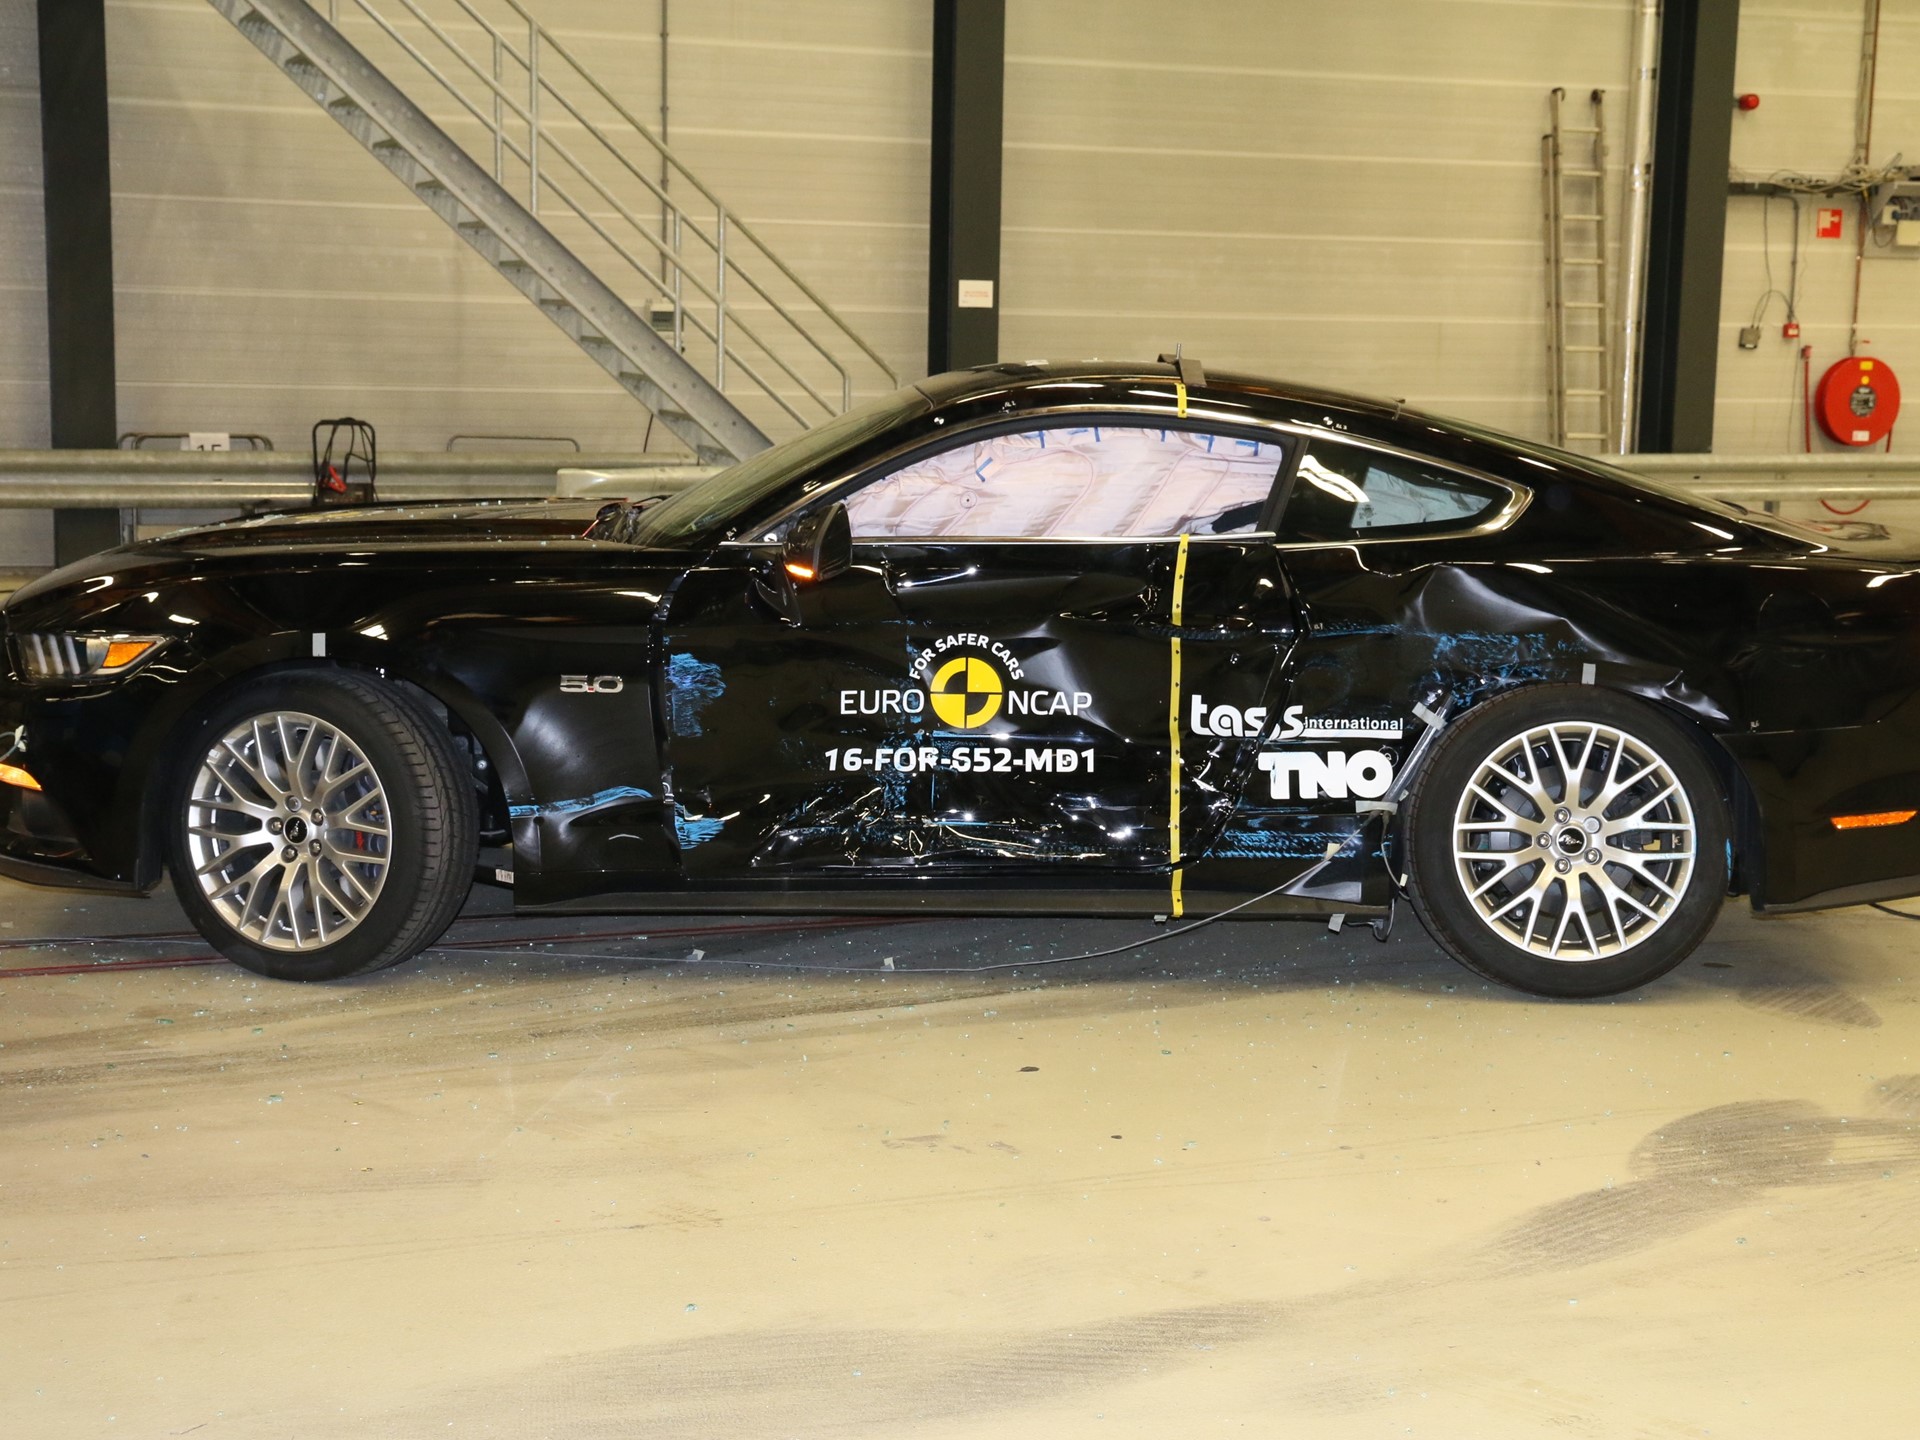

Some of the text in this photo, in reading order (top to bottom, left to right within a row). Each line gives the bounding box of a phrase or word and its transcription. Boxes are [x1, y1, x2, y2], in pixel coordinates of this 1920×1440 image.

[909, 632, 1025, 681] FOR SAFER CARS
[559, 674, 624, 693] 5.0
[840, 688, 1093, 716] EURO NCAP
[1304, 716, 1404, 731] international
[825, 747, 1095, 773] 16-FOR-S52-MD1
[1257, 749, 1394, 800] TNO
